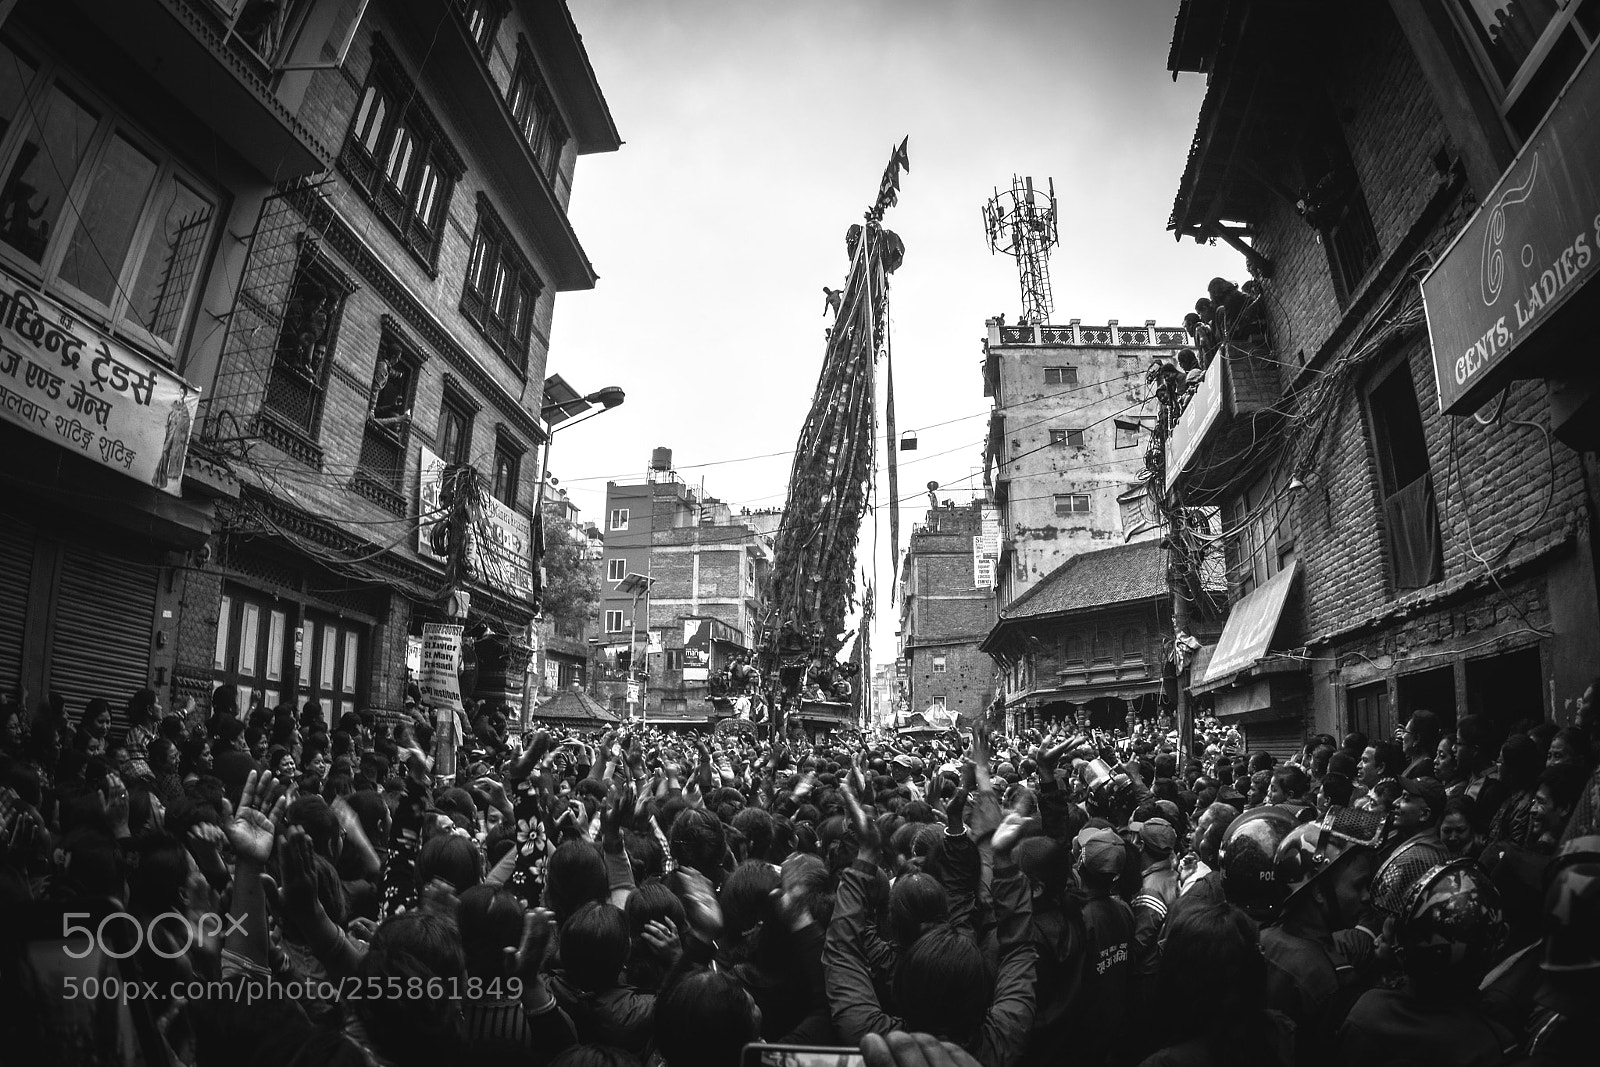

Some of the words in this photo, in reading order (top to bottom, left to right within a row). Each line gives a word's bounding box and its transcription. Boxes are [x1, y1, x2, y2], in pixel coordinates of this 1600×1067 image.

[1455, 315, 1514, 386] GENTS,
[1514, 232, 1592, 330] LADIES
[26, 359, 65, 400] एण्ड
[433, 652, 453, 661] Mary
